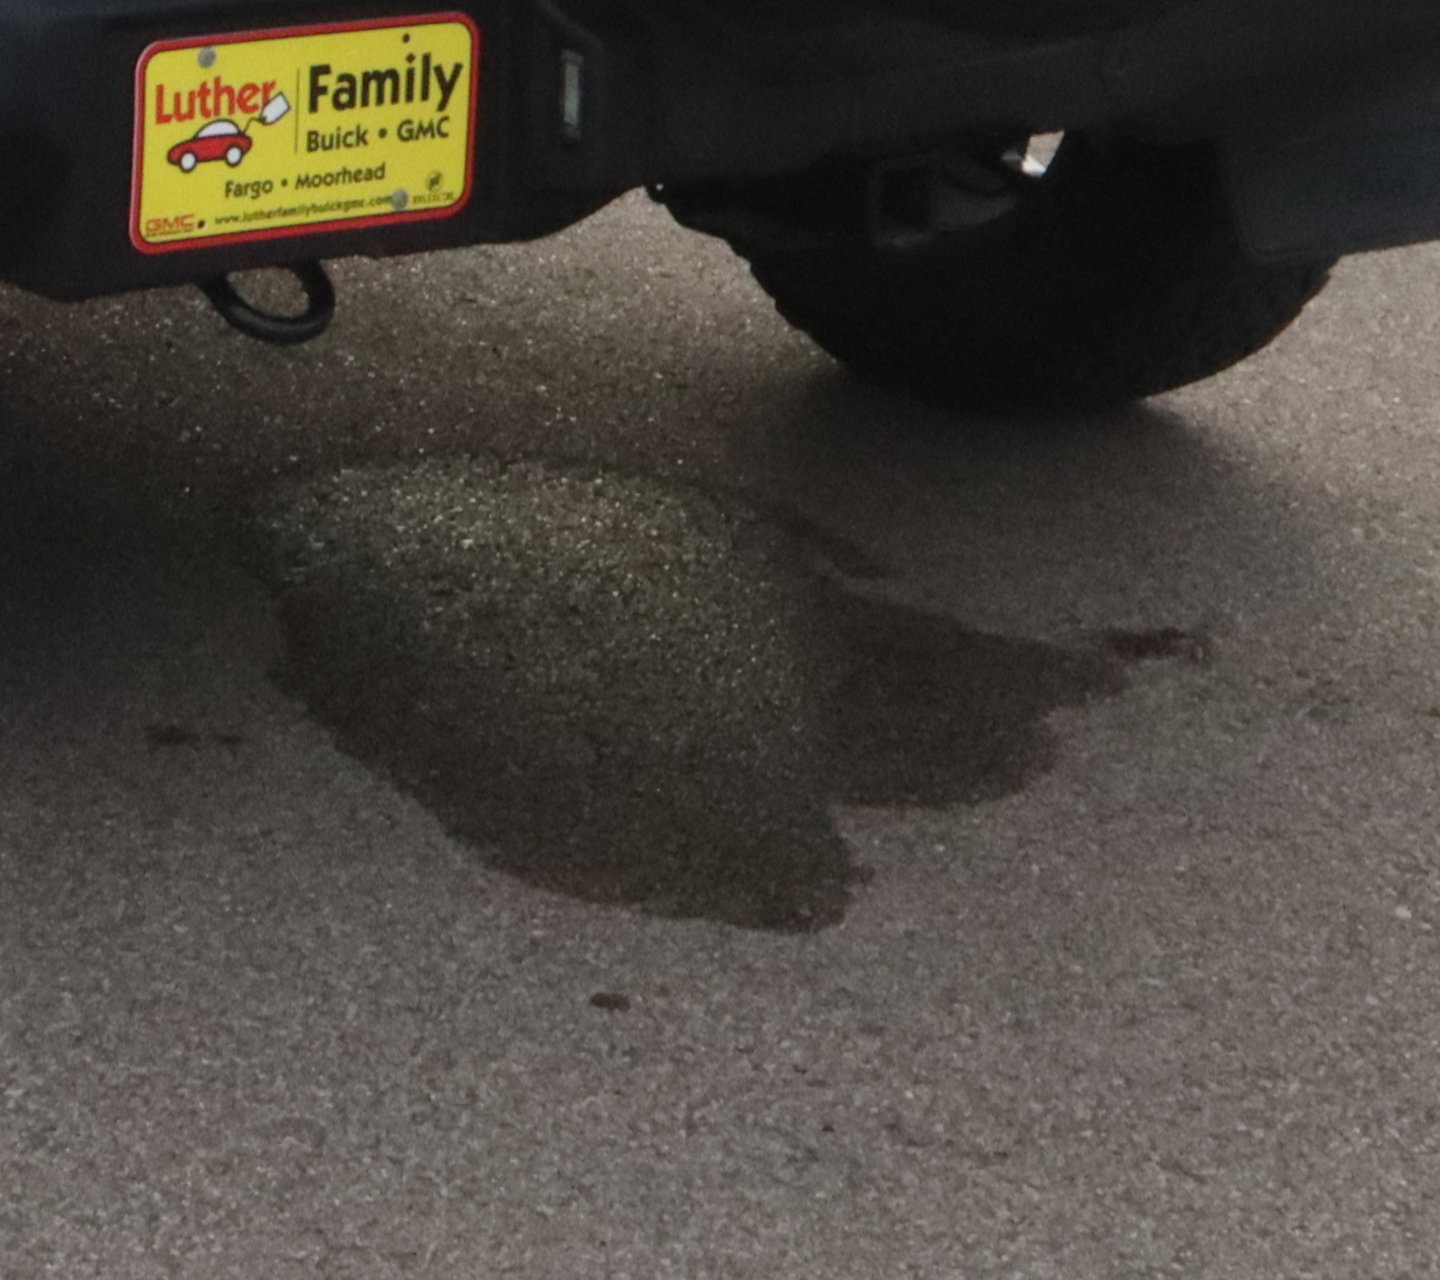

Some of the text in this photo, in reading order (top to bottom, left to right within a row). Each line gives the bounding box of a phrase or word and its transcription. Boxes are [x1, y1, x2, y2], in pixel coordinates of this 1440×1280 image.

[155, 76, 276, 125] Luther
[308, 52, 463, 114] Family
[306, 116, 450, 153] Buick GMC
[224, 162, 386, 200] Fargo Moorhead
[145, 213, 195, 233] GMC
